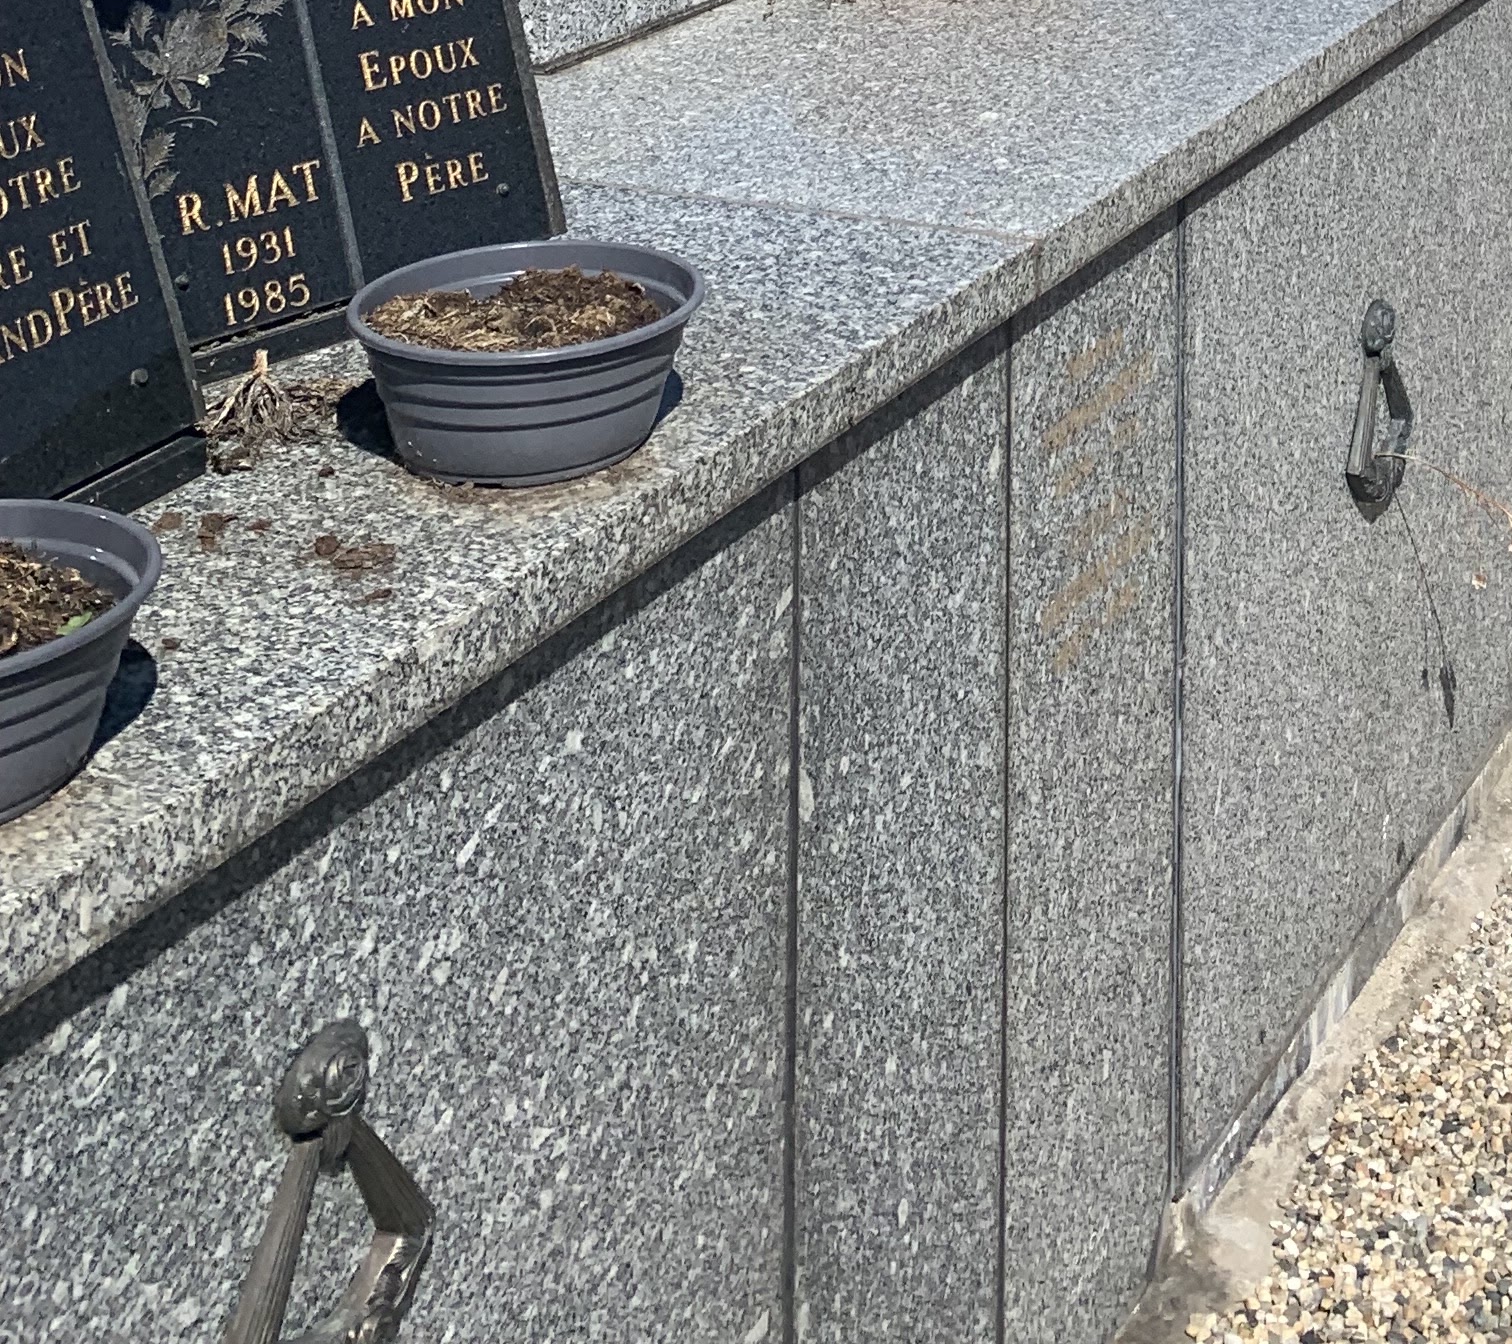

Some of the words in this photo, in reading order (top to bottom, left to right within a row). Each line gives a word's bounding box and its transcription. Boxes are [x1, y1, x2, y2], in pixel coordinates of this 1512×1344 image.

[351, 0, 375, 30] A
[358, 37, 480, 92] EPOUX
[356, 116, 382, 149] A
[390, 82, 508, 138] NOTRE
[394, 151, 490, 203] PÈRE
[49, 219, 92, 268] ET
[221, 225, 296, 277] 1931
[0, 271, 139, 365] NDPÈRE
[222, 272, 312, 326] 1985
